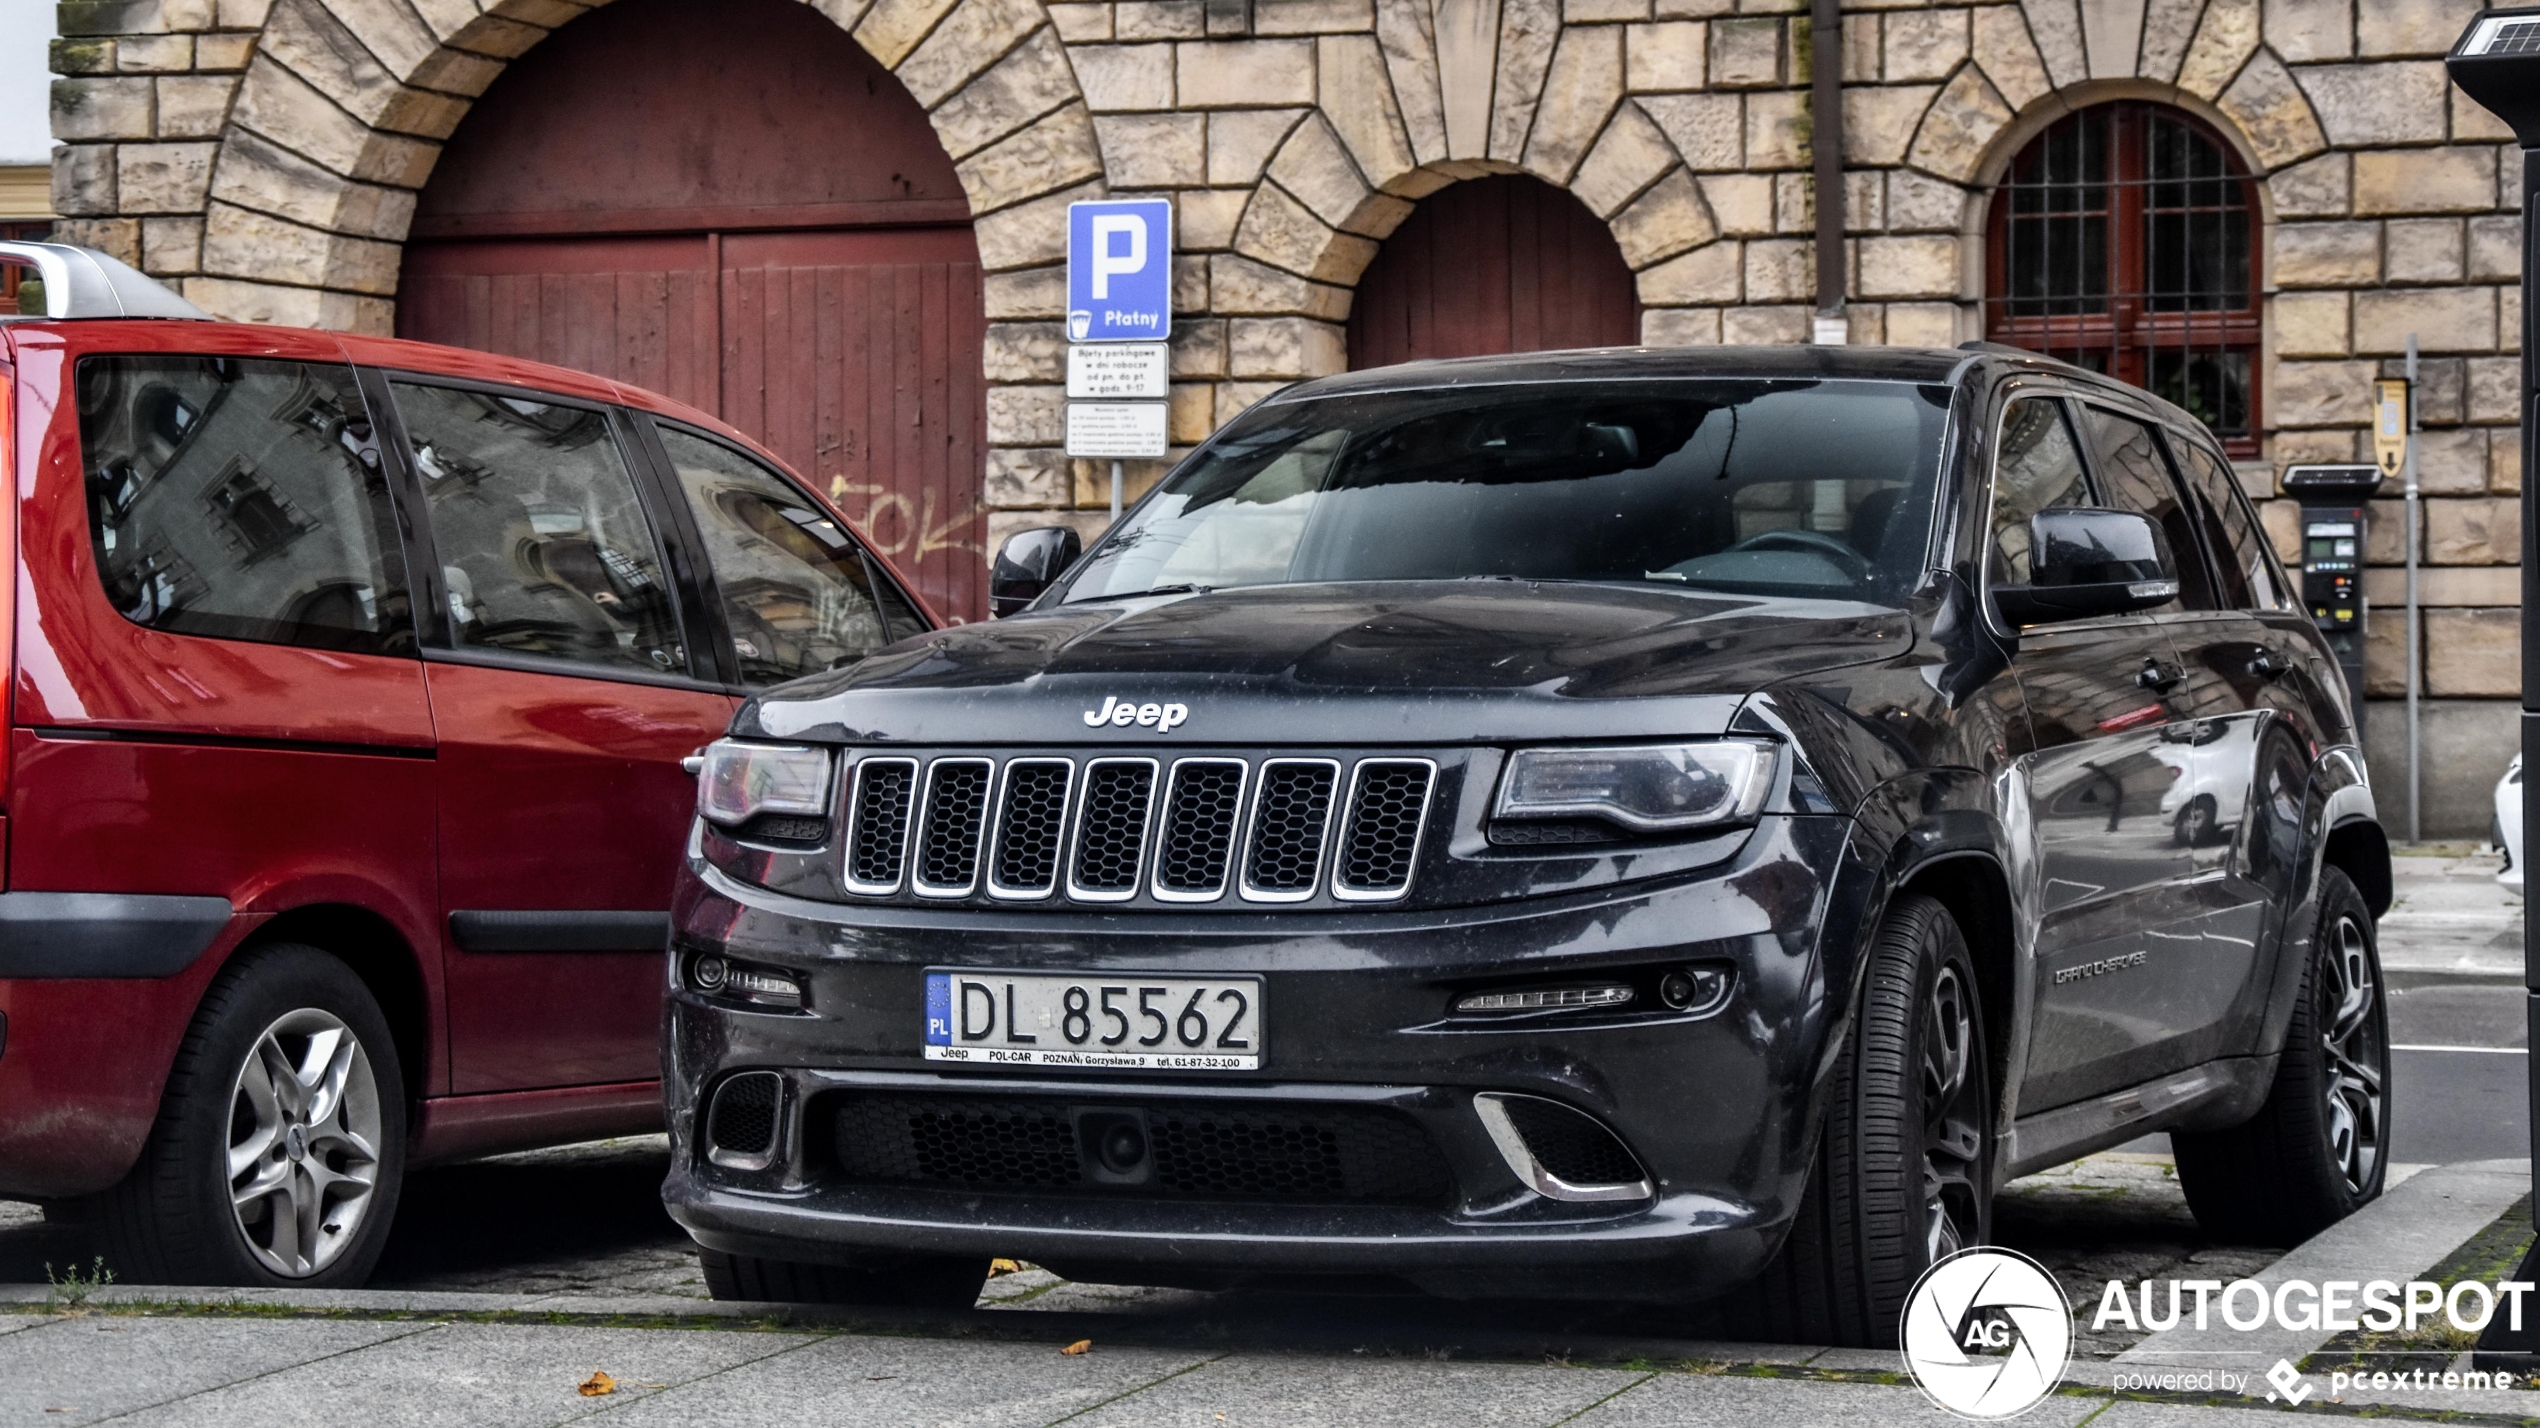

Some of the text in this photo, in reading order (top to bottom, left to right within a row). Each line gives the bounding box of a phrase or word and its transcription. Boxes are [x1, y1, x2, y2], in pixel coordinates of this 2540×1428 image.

[1092, 214, 1148, 300] P
[1105, 309, 1159, 330] Płatny
[1105, 349, 1156, 359] parkingowe
[1096, 361, 1110, 369] dni
[1084, 696, 1189, 733] Jeep
[961, 981, 1249, 1049] DL 85562
[929, 1018, 949, 1036] PL
[940, 1047, 969, 1059] Jeep
[989, 1051, 1032, 1062] POL-CAR
[1139, 1057, 1145, 1066] 9
[1157, 1058, 1172, 1067] tel.
[1175, 1058, 1240, 1069] 61-87-32-100
